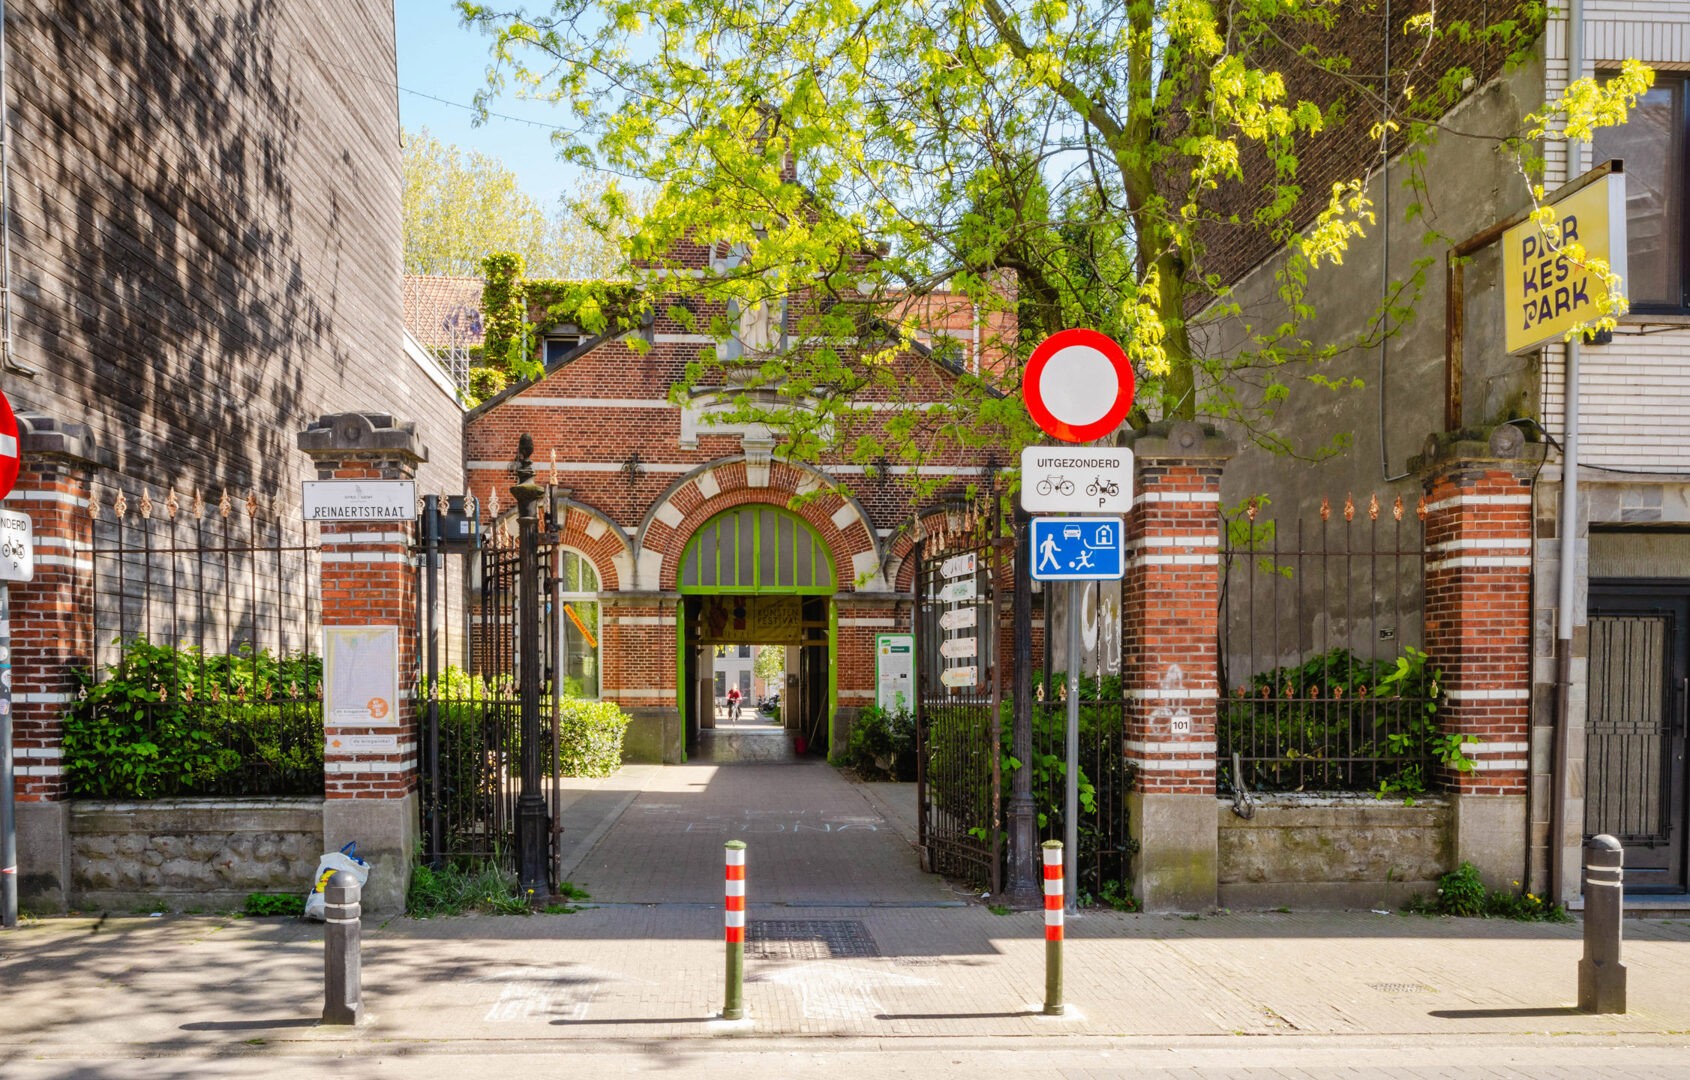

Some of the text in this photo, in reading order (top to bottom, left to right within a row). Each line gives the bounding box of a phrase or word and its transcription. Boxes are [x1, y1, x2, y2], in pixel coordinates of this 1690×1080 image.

[1523, 254, 1569, 298] KES
[1523, 277, 1589, 330] PARK
[1037, 458, 1120, 468] UITGEZONDERD
[1099, 497, 1106, 508] P
[312, 506, 405, 518] REINAERTSTRAAT
[13, 561, 18, 571] P
[757, 616, 799, 625] FESTVAL
[1172, 721, 1188, 730] 101
